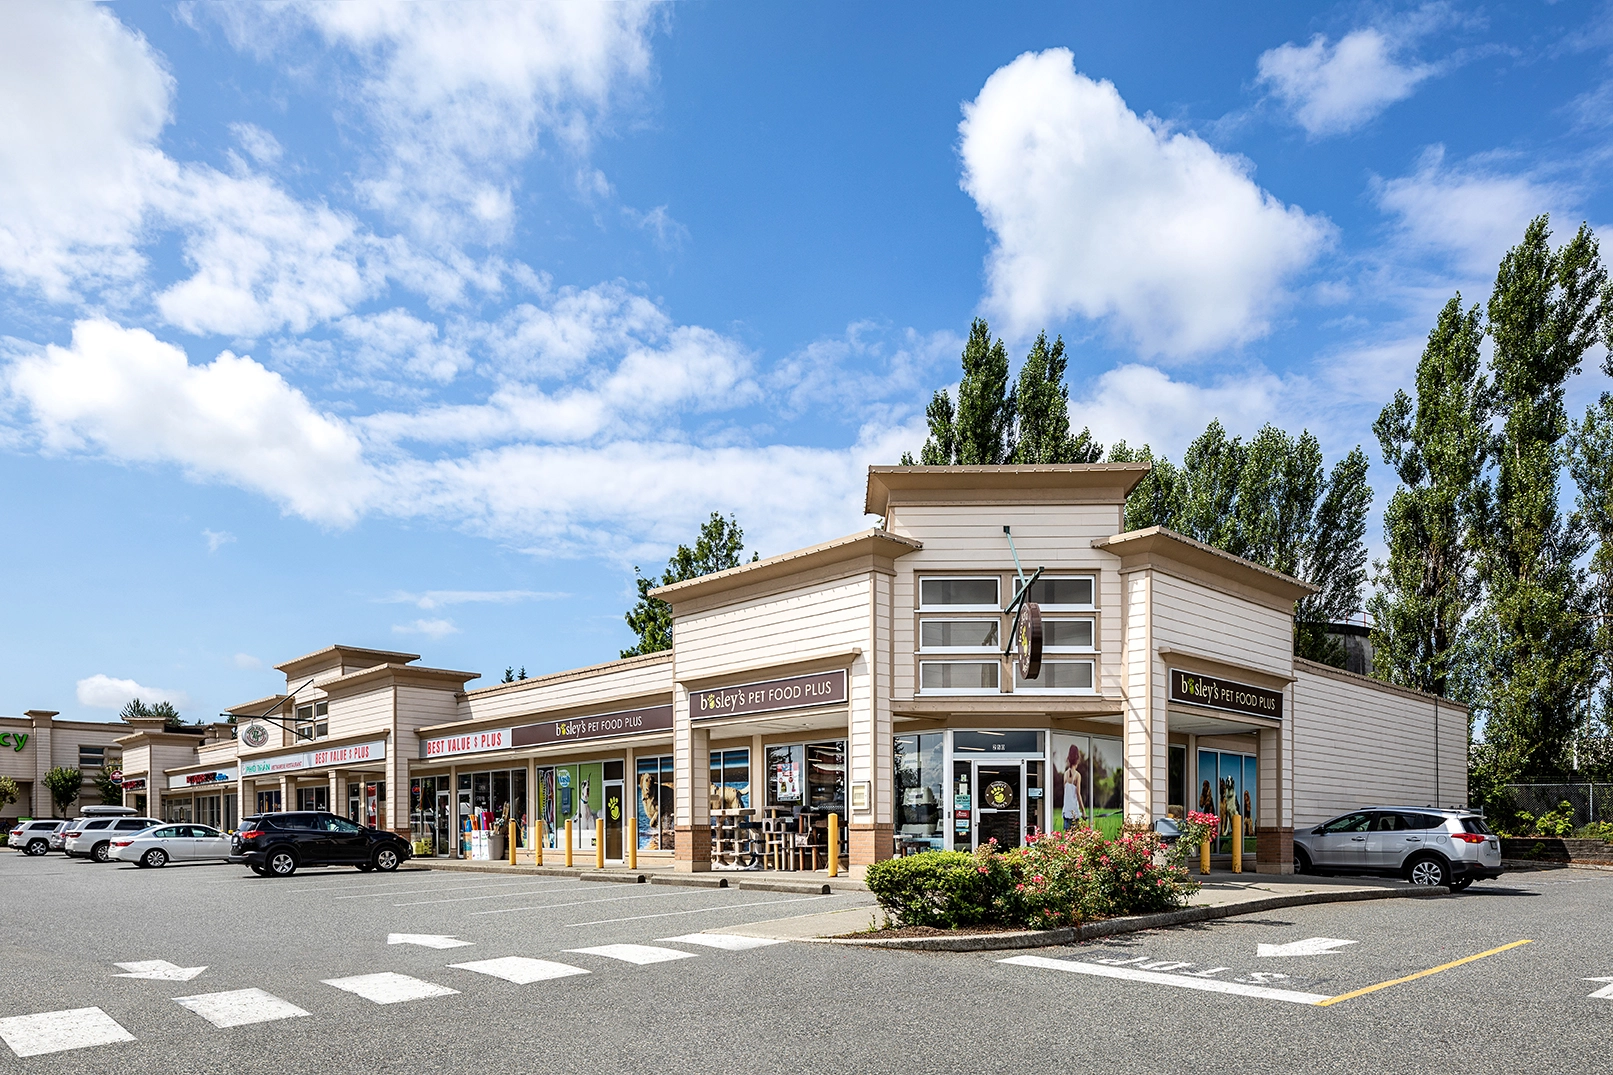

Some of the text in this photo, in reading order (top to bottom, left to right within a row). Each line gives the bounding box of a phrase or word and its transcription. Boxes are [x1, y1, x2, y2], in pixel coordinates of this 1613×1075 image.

[748, 690, 765, 704] PET
[768, 685, 801, 701] FOOD
[804, 680, 831, 697] PLUS
[1221, 688, 1234, 702] PET
[1235, 691, 1258, 707] FOOD
[1259, 696, 1276, 711] PLUS
[587, 721, 600, 732] PET
[601, 718, 623, 731] FOOD
[624, 715, 643, 728] PLUS
[315, 752, 328, 765] BEST
[330, 748, 347, 763] VALUE
[354, 745, 370, 759] PLUS
[427, 740, 445, 755] BEST
[447, 736, 471, 752] VALUE
[481, 732, 502, 748] PLUS
